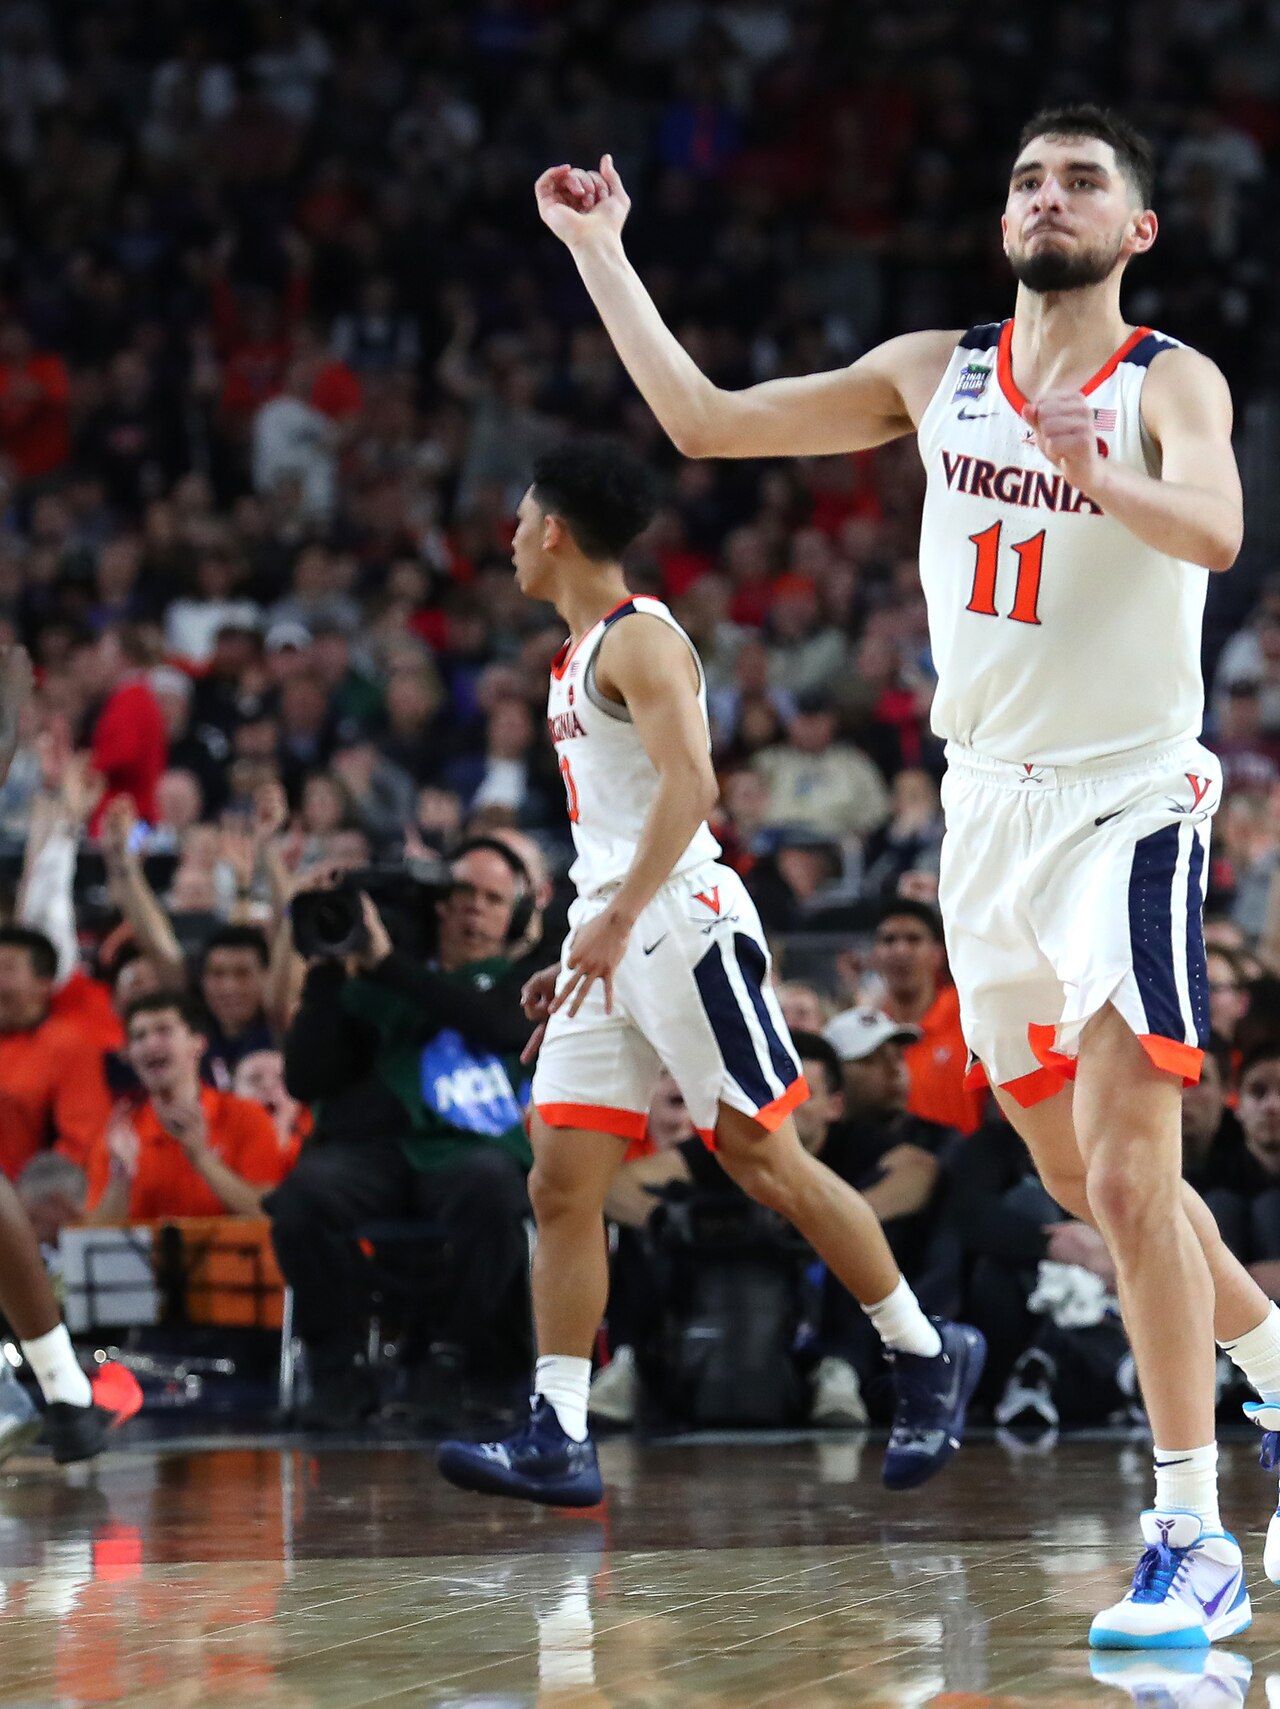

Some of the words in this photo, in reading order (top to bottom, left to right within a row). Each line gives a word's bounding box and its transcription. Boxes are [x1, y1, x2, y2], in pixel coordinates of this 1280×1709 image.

[960, 372, 986, 383] FINAL
[956, 380, 983, 392] FOUR
[966, 520, 1046, 625] 11
